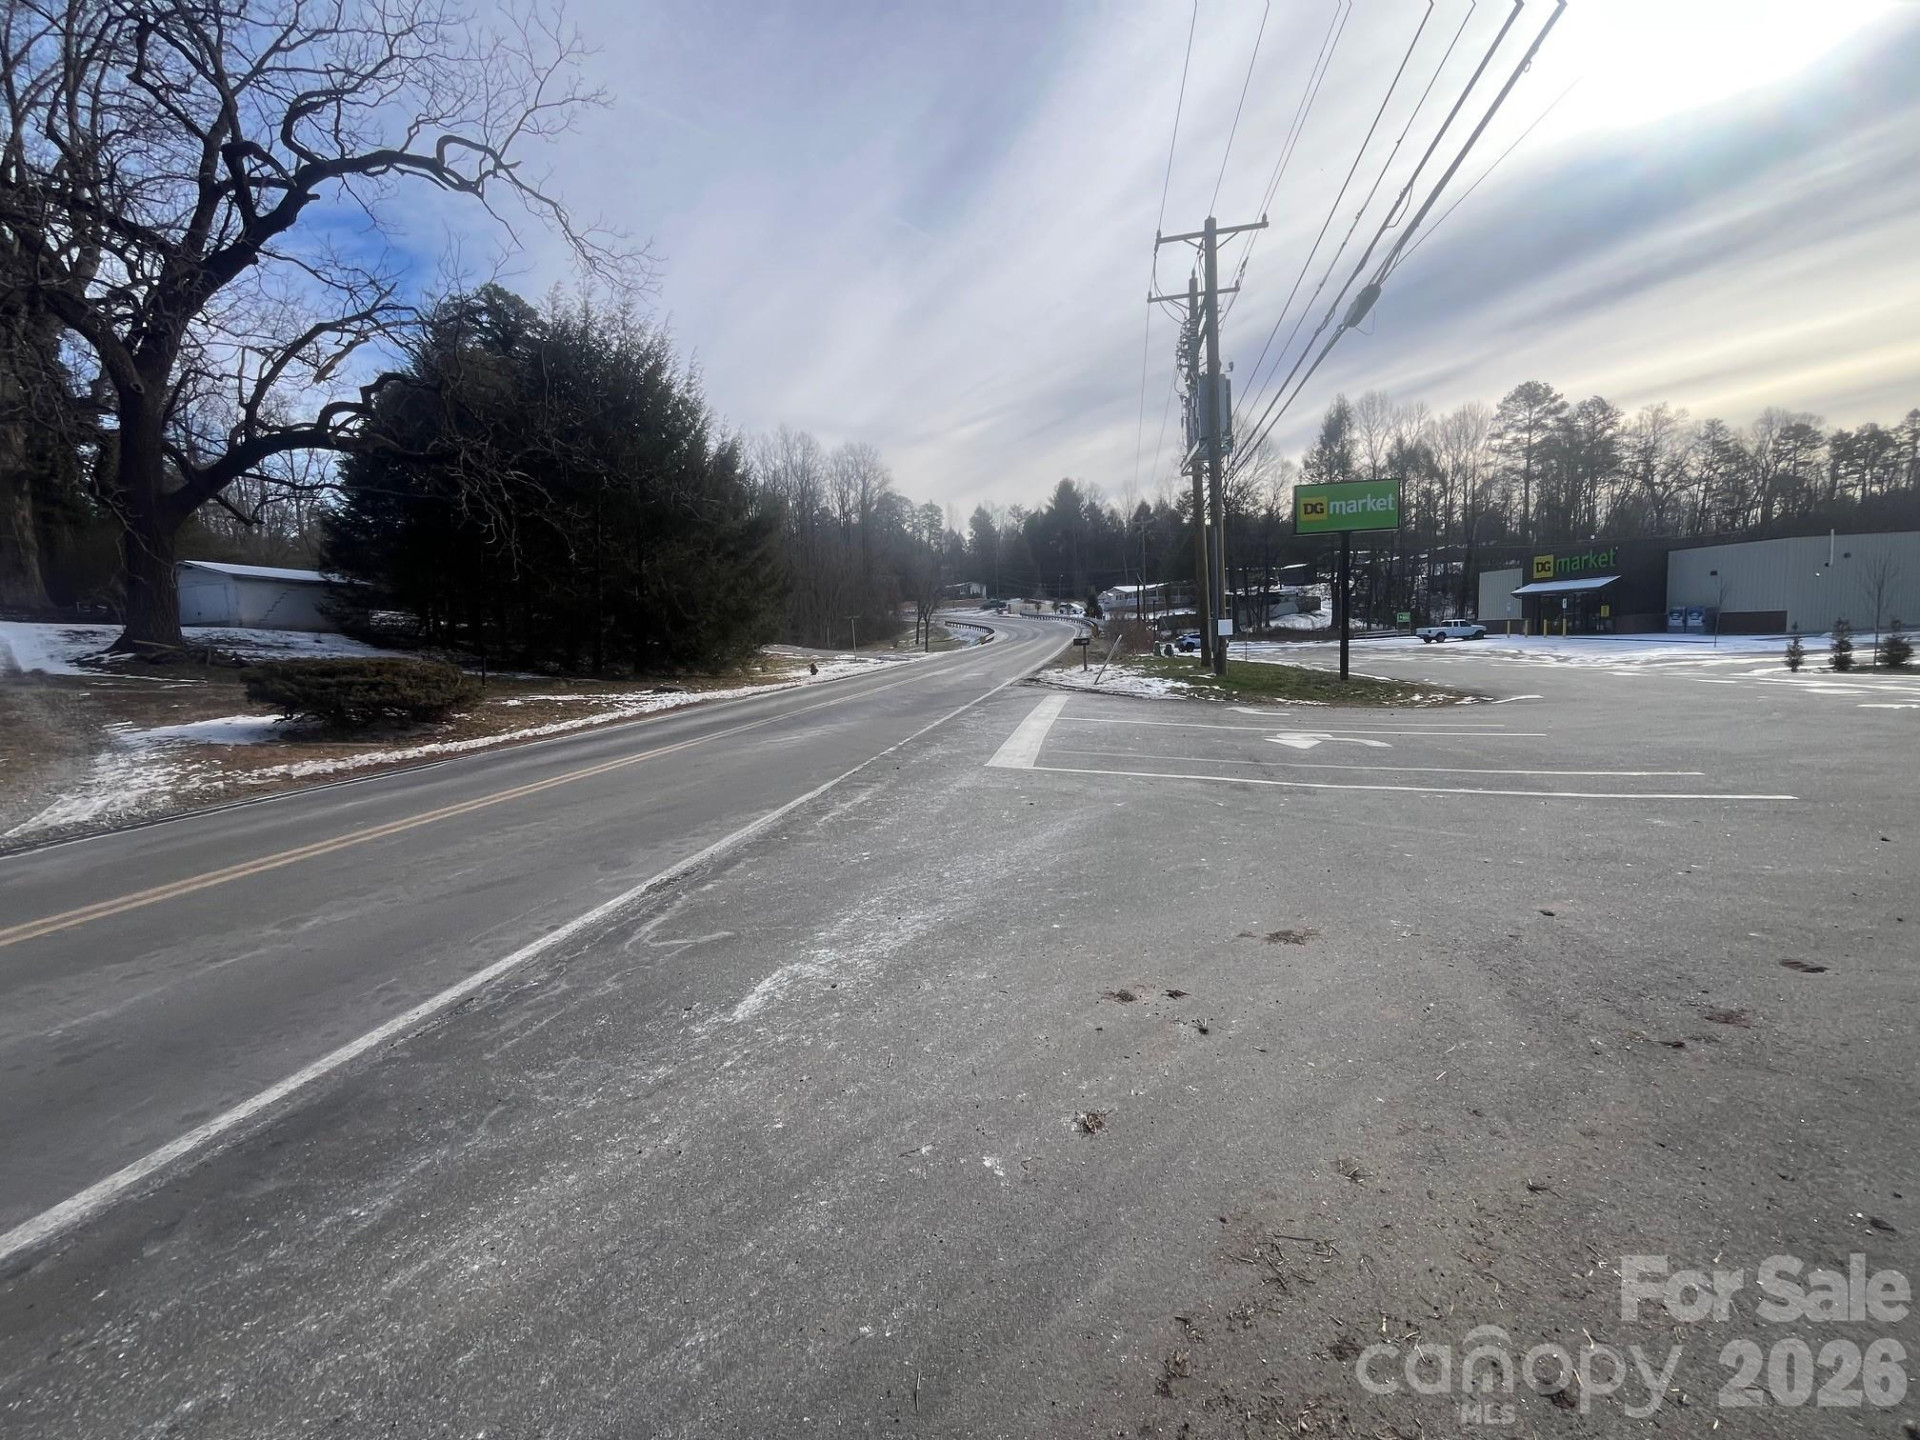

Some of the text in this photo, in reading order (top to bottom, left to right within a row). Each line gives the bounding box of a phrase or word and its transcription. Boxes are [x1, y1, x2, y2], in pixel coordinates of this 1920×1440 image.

[1303, 493, 1395, 515] DG market
[1535, 548, 1616, 573] DG market
